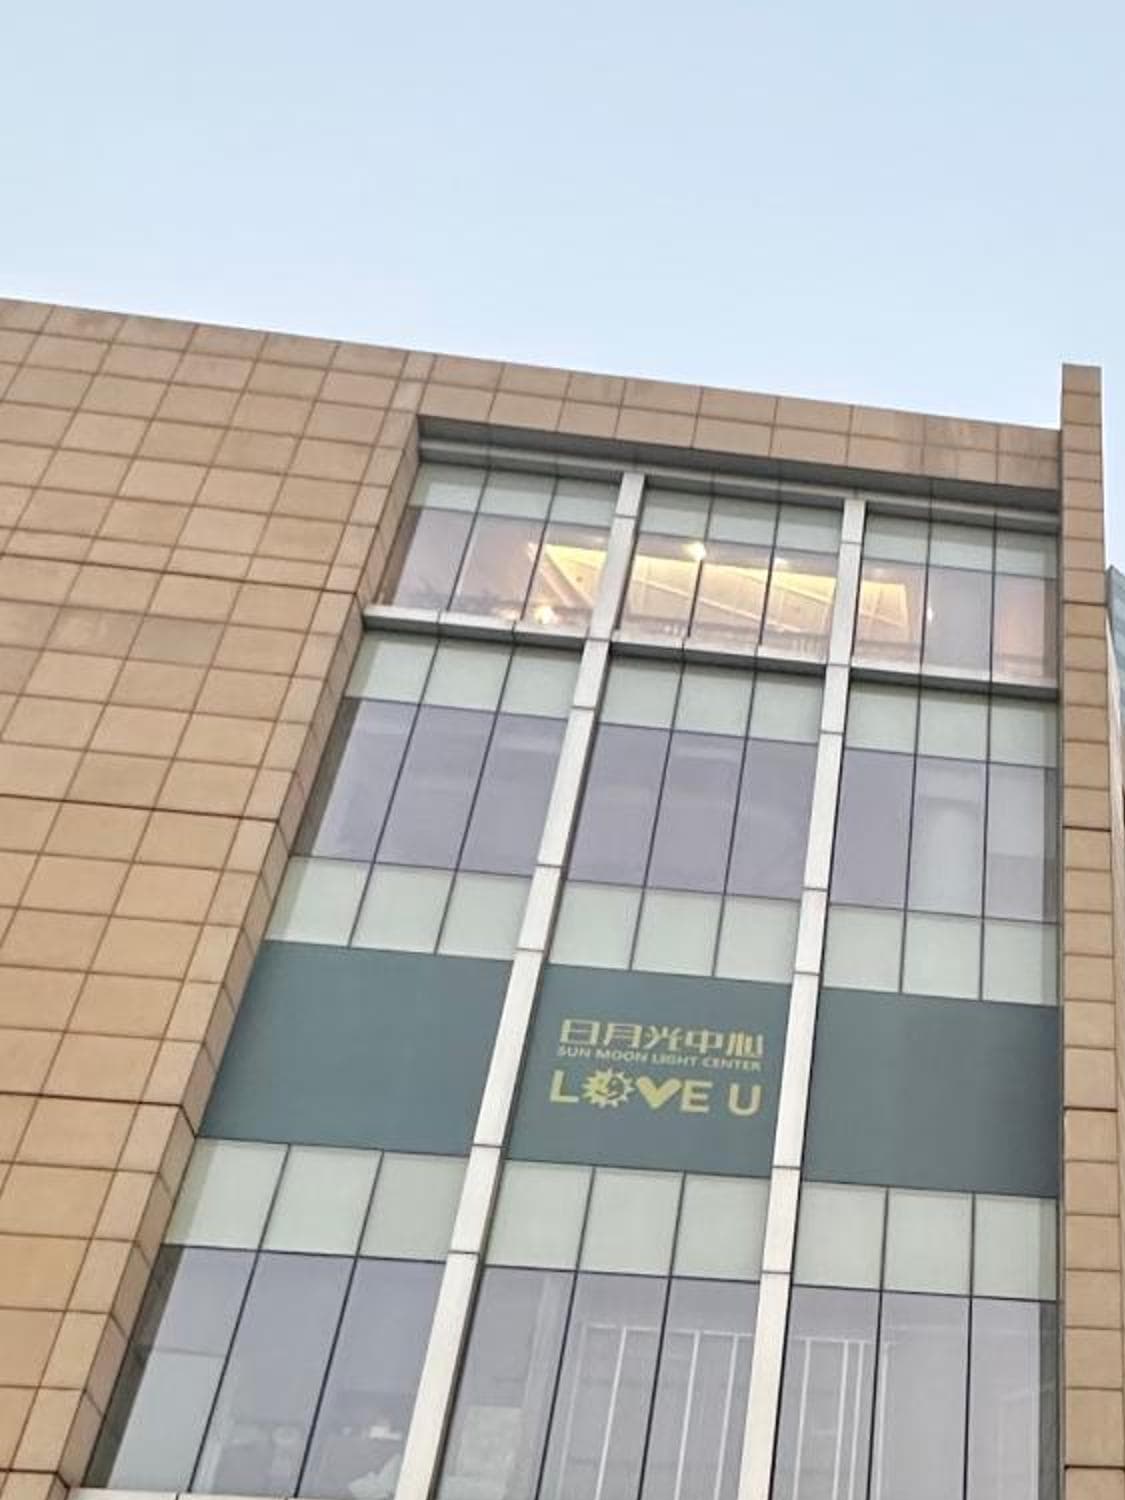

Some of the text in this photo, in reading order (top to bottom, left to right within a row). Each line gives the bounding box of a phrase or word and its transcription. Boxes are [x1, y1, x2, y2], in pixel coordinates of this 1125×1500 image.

[559, 1018, 764, 1058] 日月光中心
[557, 1046, 762, 1072] SUN MOON LIGHT CENTER
[727, 1082, 763, 1116] U
